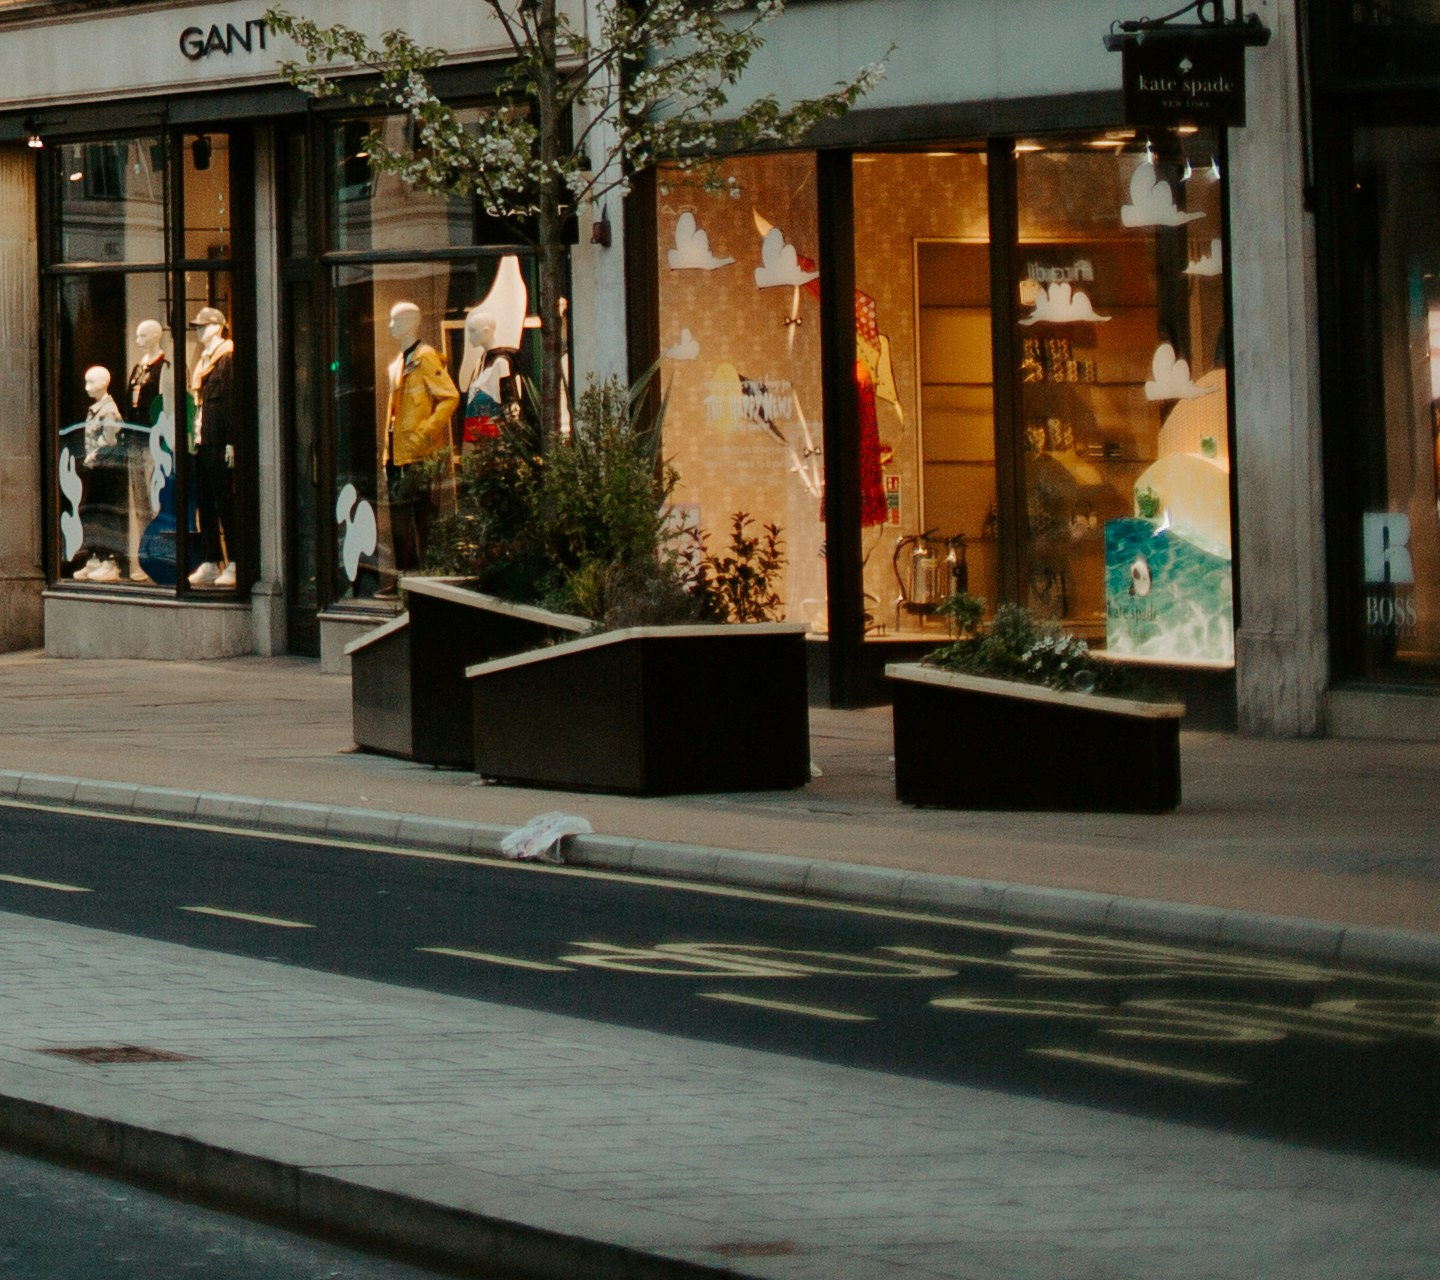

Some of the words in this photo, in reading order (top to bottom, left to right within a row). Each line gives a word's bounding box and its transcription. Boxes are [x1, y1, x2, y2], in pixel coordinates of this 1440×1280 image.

[179, 19, 268, 61] GANT
[1139, 74, 1177, 91] kate
[1183, 76, 1234, 97] spade
[1366, 596, 1418, 628] BOSS
